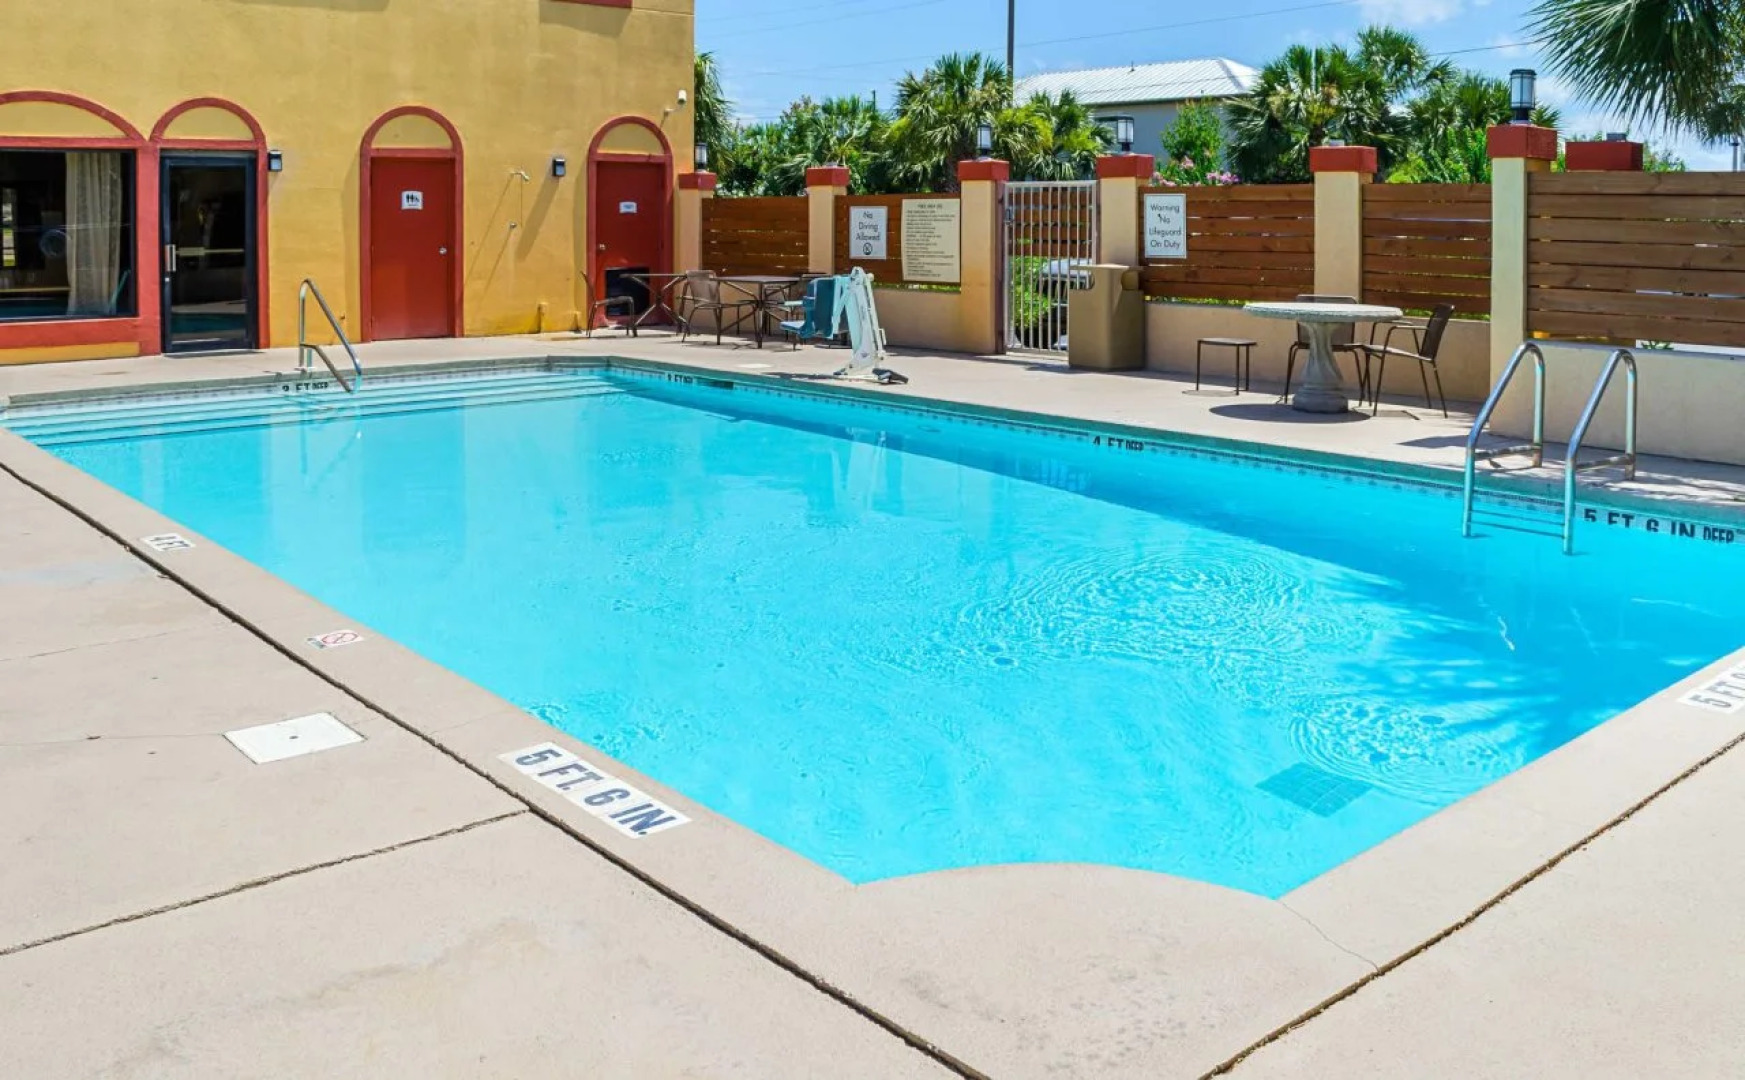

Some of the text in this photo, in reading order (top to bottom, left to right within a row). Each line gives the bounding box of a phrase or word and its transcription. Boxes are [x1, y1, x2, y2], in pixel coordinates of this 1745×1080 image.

[1151, 204, 1180, 214] Warning
[863, 211, 873, 219] No
[1159, 215, 1171, 224] No
[858, 222, 879, 232] Diving
[855, 232, 880, 241] Allowed
[1149, 227, 1182, 238] Lifeguard
[1150, 239, 1180, 250] On Duty
[1584, 508, 1597, 522] 5
[1607, 512, 1634, 528] FT
[1670, 521, 1696, 538] IN
[1687, 693, 1733, 709] 5
[515, 748, 677, 836] 5 FT. 6 IN.
